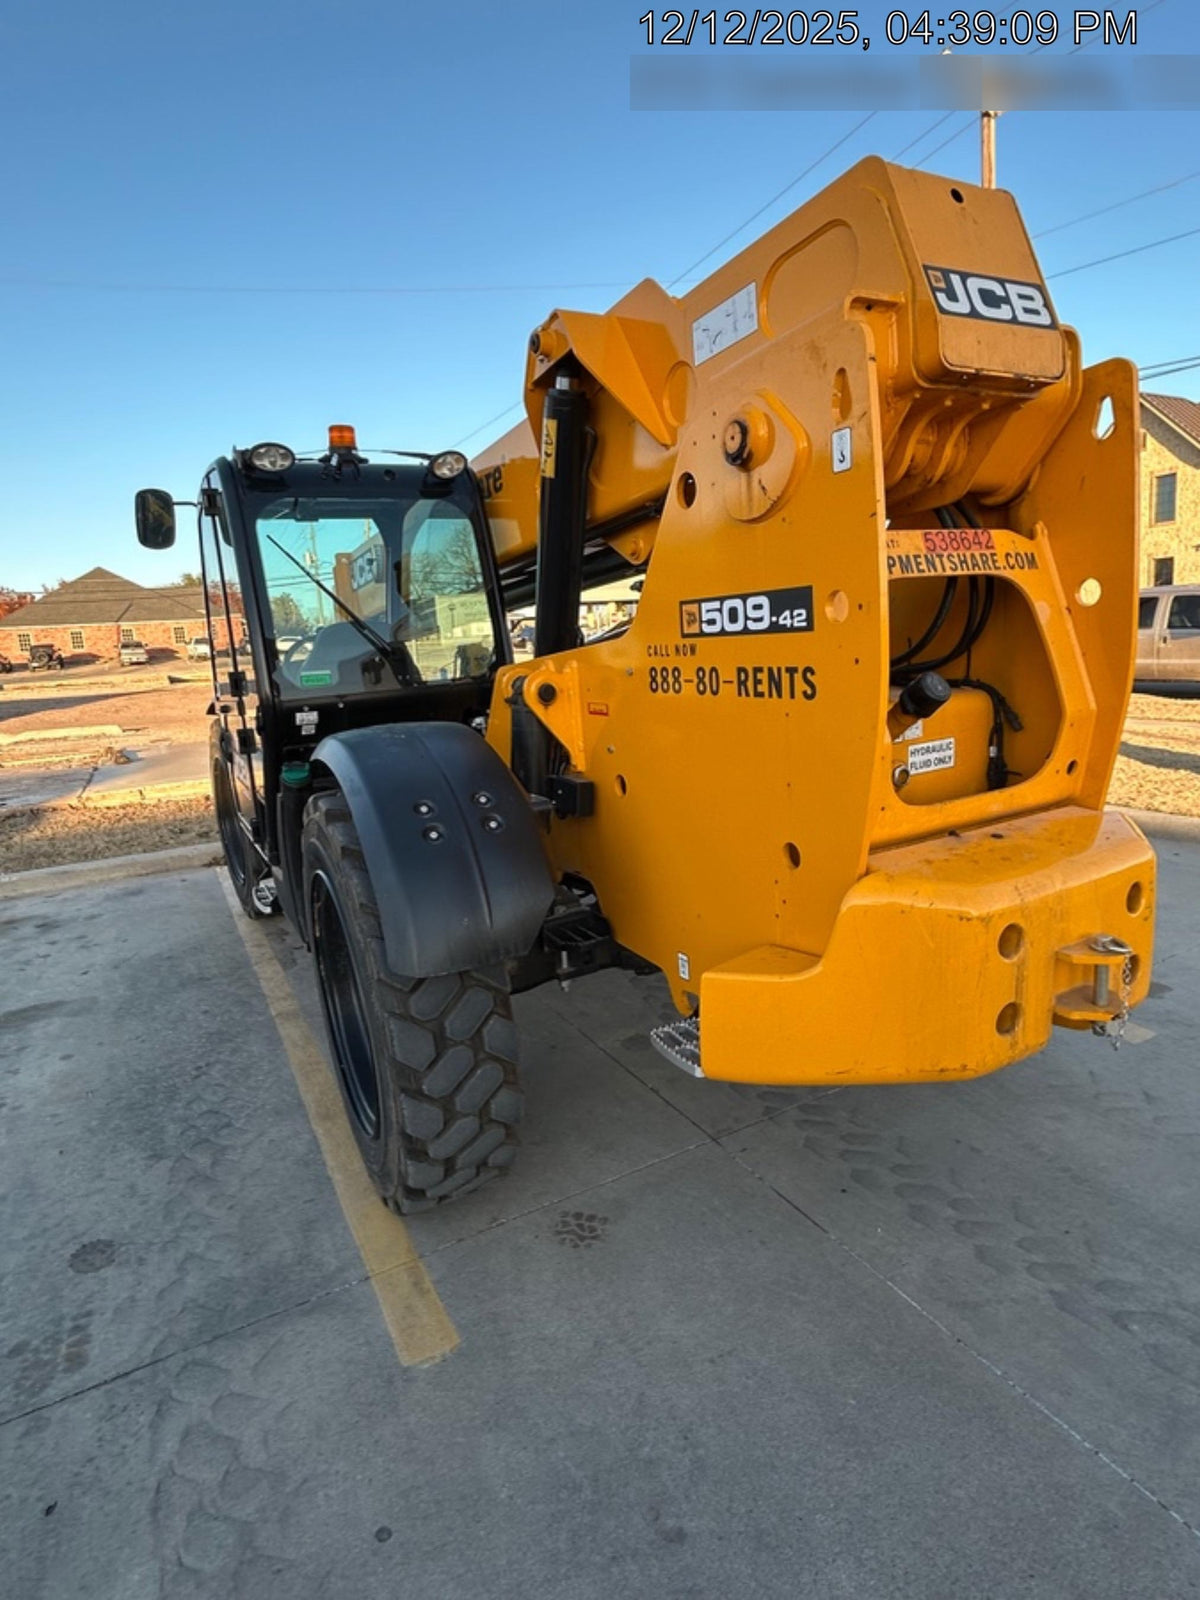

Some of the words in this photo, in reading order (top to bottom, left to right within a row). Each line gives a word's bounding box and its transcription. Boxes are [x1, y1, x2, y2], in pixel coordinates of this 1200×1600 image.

[935, 272, 1053, 326] JCB
[923, 528, 995, 552] 538642
[887, 551, 1040, 575] PMENTSHARE.COM
[647, 644, 671, 658] CALL
[674, 642, 698, 657] NOW
[649, 665, 818, 701] 888-80-RENTS
[909, 740, 953, 758] HYDRAULIC
[909, 758, 933, 771] FLUID
[933, 755, 952, 767] ONLY
